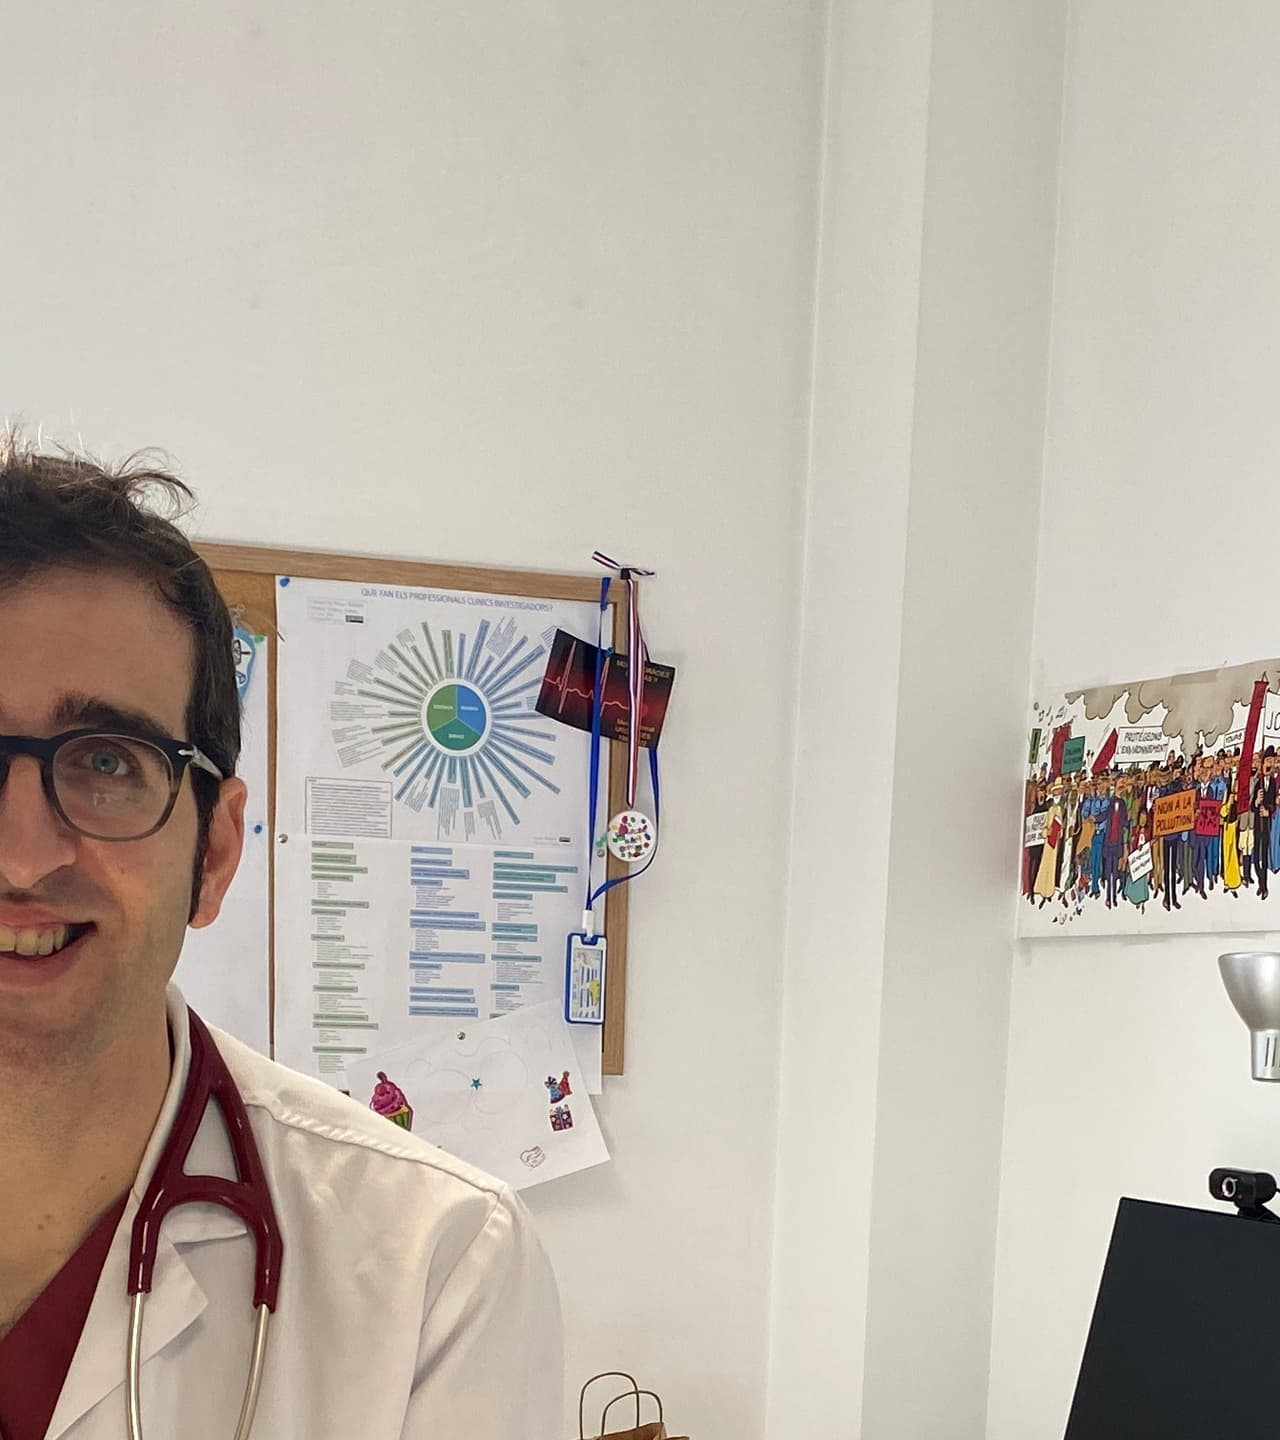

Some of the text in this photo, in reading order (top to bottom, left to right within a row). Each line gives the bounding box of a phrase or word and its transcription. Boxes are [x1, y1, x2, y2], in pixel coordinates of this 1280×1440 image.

[1157, 800, 1174, 815] NON
[1182, 797, 1192, 810] LA
[1155, 815, 1192, 831] POLLUTION
